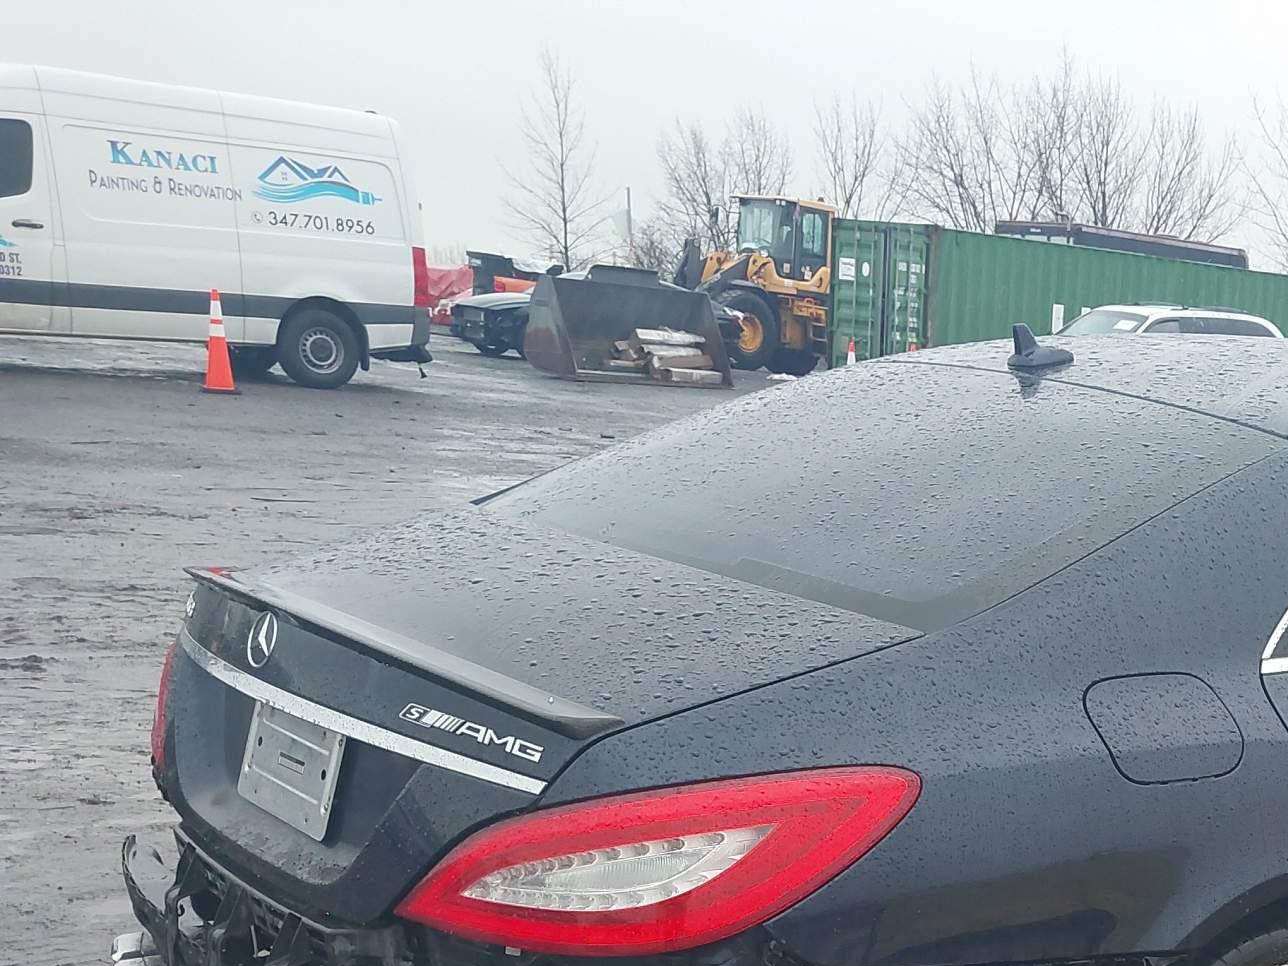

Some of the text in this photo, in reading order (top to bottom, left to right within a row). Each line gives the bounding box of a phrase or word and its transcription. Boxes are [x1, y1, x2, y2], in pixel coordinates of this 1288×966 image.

[107, 139, 219, 174] KANACI
[88, 169, 242, 201] PAINTING & RENOVATION
[268, 211, 375, 235] 347.701.8956
[9, 253, 22, 264] ST.
[456, 721, 544, 763] AMG
